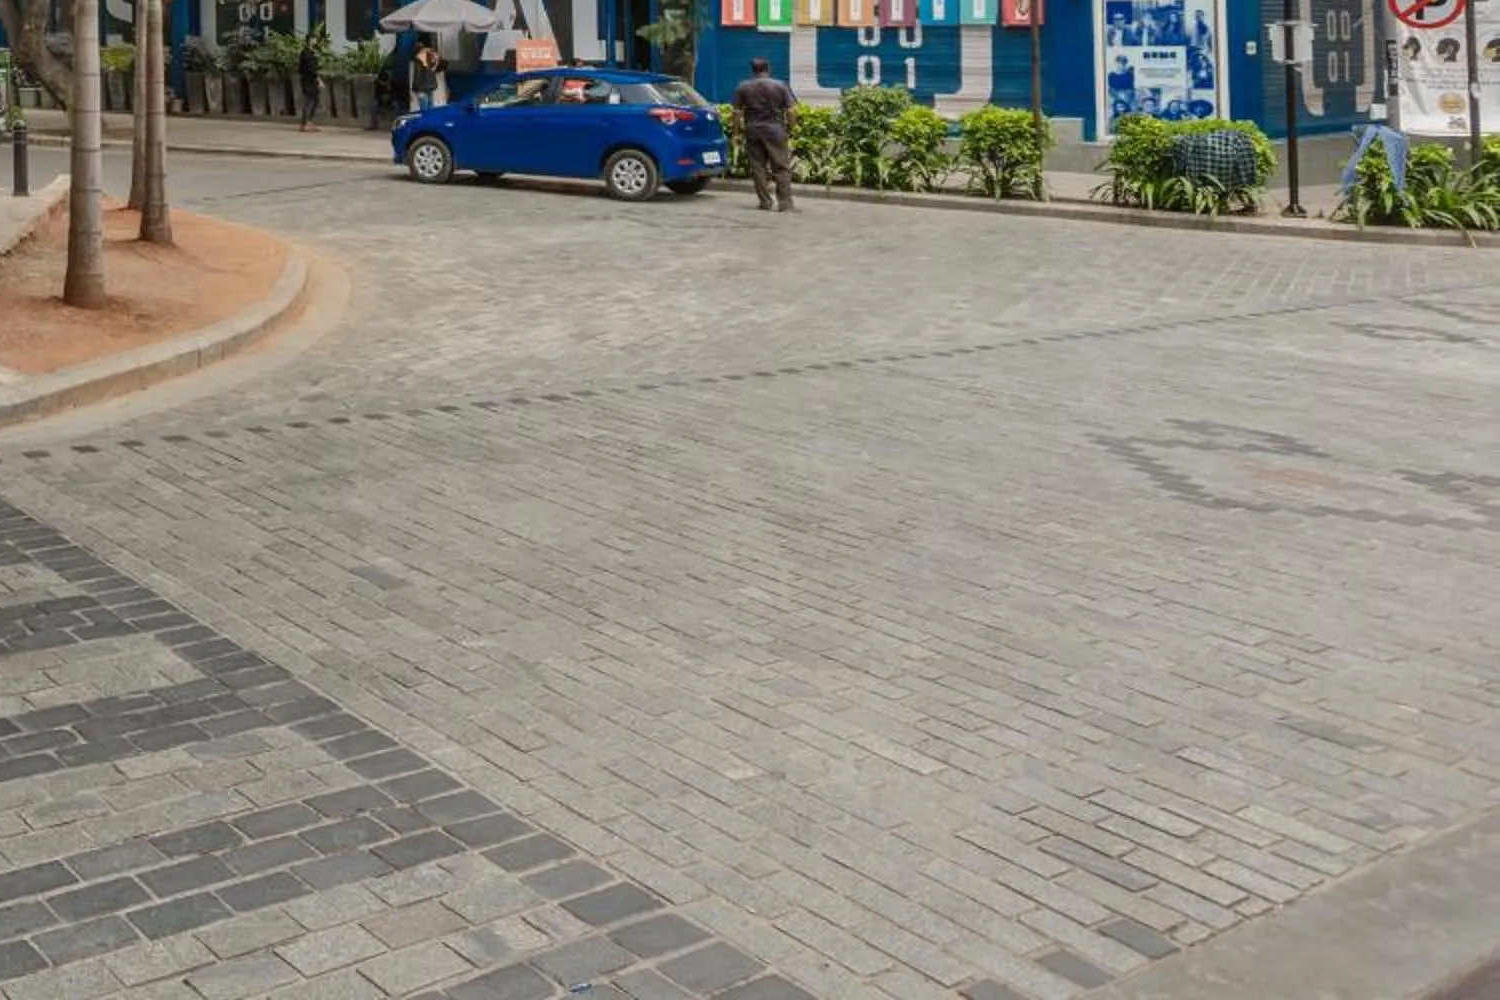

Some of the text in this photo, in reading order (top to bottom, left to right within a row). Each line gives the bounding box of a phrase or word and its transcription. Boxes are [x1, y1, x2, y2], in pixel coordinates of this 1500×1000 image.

[1325, 8, 1352, 42] 00
[856, 55, 918, 89] 01
[1327, 50, 1351, 84] 01
